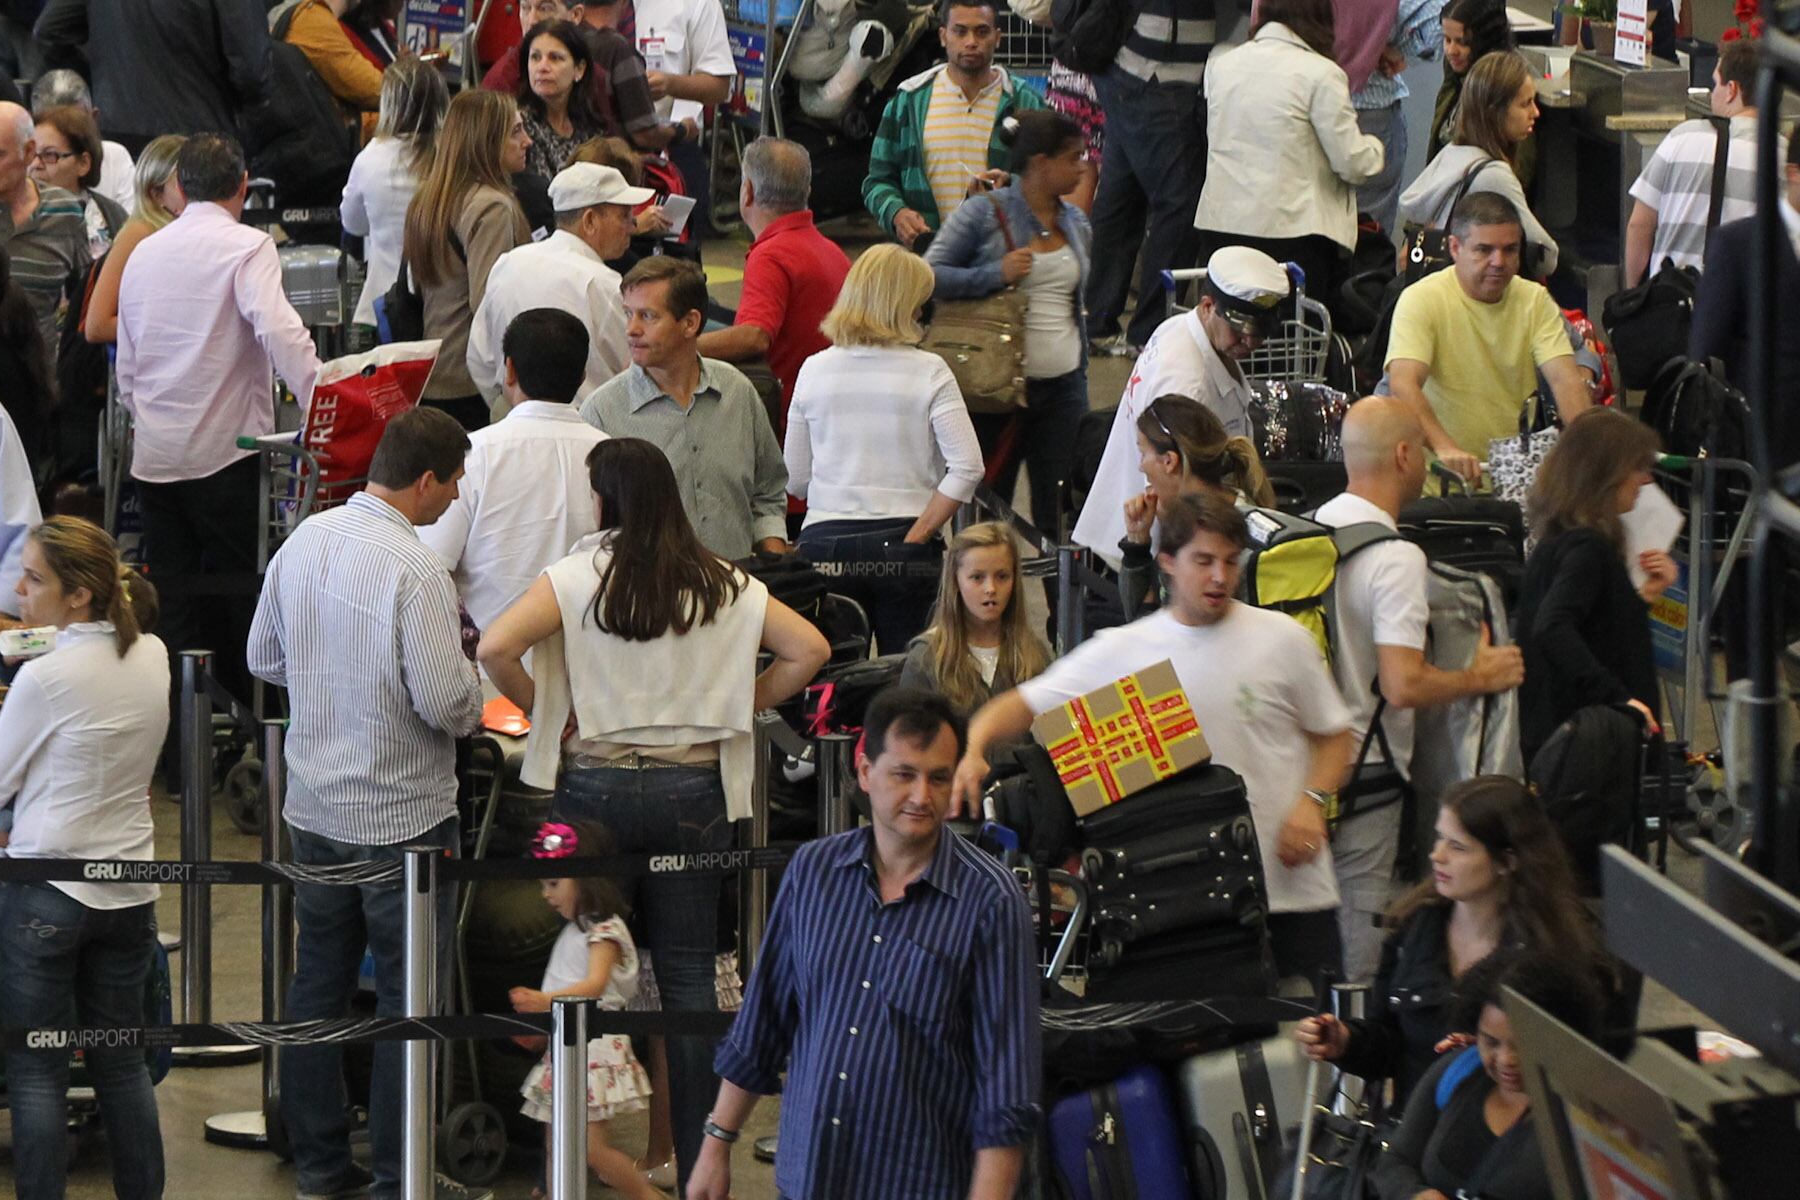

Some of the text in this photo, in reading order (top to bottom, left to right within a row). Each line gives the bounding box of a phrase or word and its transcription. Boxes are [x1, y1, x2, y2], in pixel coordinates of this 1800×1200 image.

[310, 394, 338, 459] FREE
[83, 862, 193, 881] GRUAIRPORT
[650, 850, 751, 873] GRUAIRPORT
[26, 1027, 141, 1048] GRUAIRPORT
